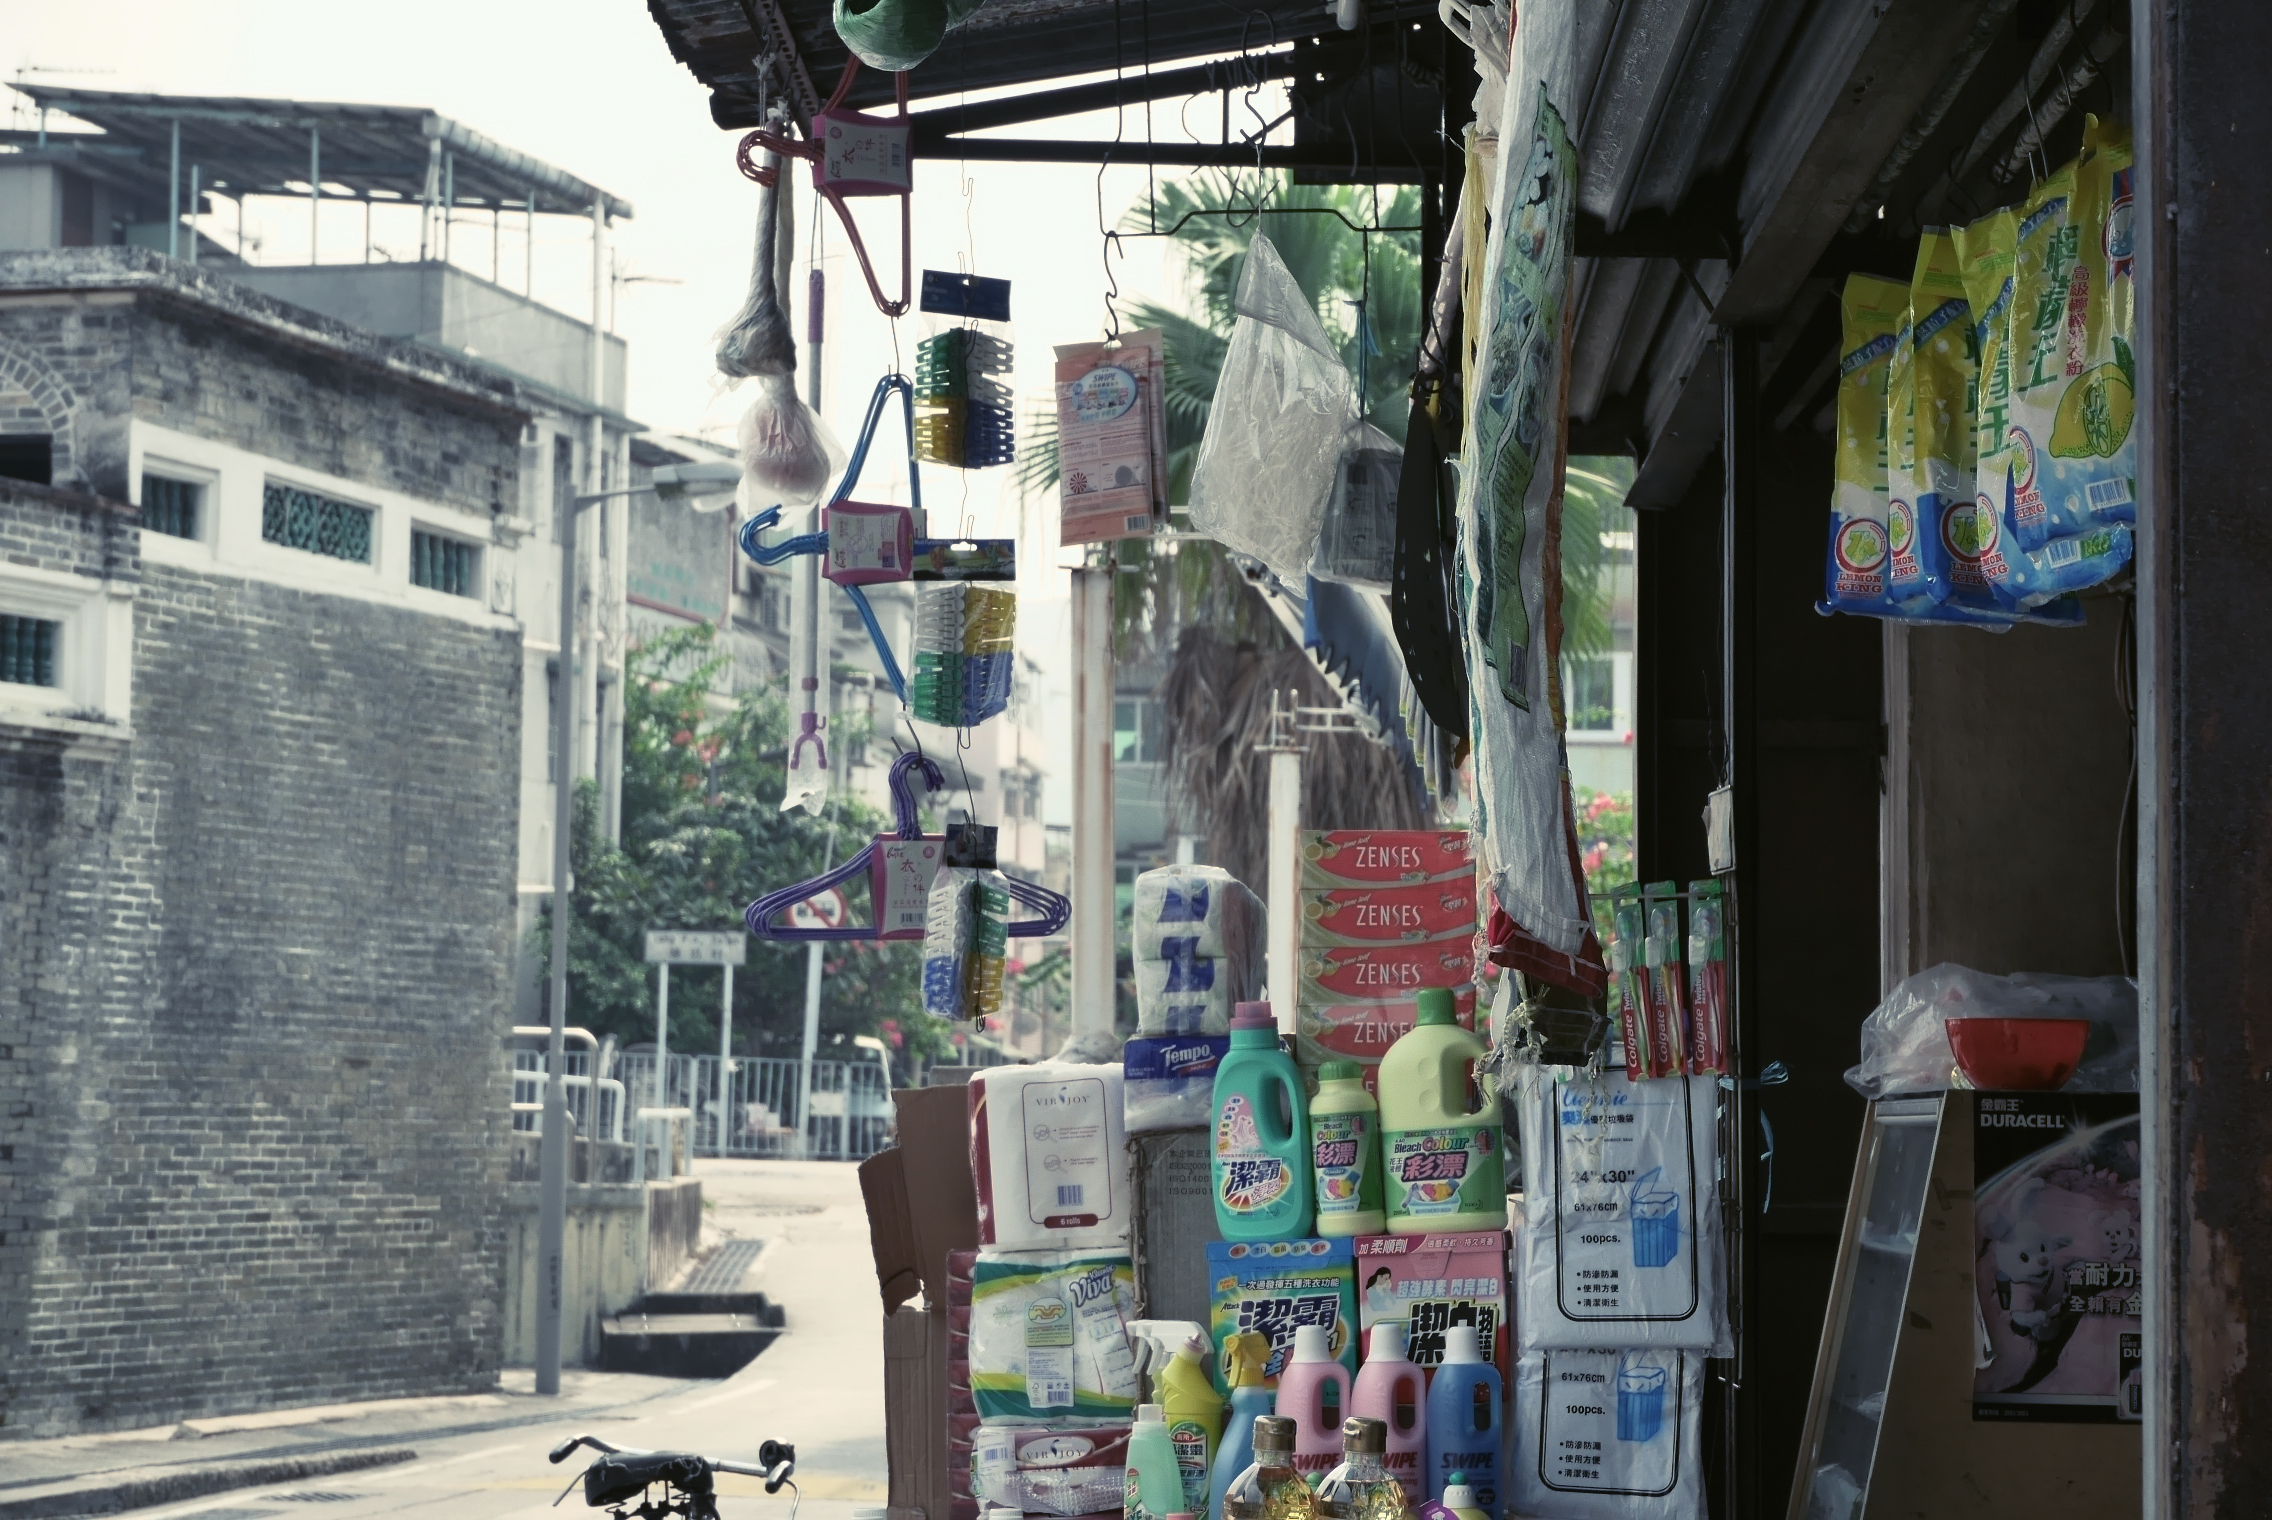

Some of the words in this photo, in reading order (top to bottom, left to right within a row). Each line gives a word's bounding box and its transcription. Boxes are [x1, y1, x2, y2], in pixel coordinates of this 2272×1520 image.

[2065, 265, 2091, 377] 高級檸檬洗衣粉
[1092, 372, 1118, 383] SWIPE
[1892, 555, 1914, 568] MON
[1981, 553, 2003, 568] MON
[1838, 573, 1882, 583] LEMON
[1892, 565, 1919, 579] ING
[1951, 572, 1984, 585] KIN
[1835, 582, 1884, 594] KING
[1356, 845, 1421, 868] ZENSES
[1356, 904, 1421, 927] ZENSES
[1355, 962, 1421, 986] ZENSES
[1353, 1021, 1416, 1044] ZENSE
[1656, 1009, 1669, 1063] Colgate
[1694, 1007, 1707, 1062] Colgate
[1626, 1013, 1637, 1068] Colgate
[1159, 1043, 1211, 1067] Tempo
[1980, 1098, 2020, 1112] 金霸王
[1980, 1113, 2065, 1129] DURACELL
[1317, 1129, 1352, 1141] Colour
[1394, 1142, 1422, 1154] Bleach
[1422, 1136, 1469, 1152] Colour
[1317, 1141, 1357, 1167] 彩漂
[1402, 1152, 1467, 1181] 彩漂
[1168, 1174, 1212, 1182] ISO1400
[1223, 1157, 1282, 1199] 潔霸
[1574, 1202, 1618, 1212] 61x76cm
[1060, 1218, 1066, 1226] 6
[1067, 1217, 1081, 1225] rolls
[1370, 1238, 1408, 1255] 柔順劑
[1580, 1234, 1621, 1245] 100pcs.
[2069, 1261, 2141, 1289] 當耐力
[1238, 1277, 1340, 1290] 一次過發揮五種洗衣功能
[1583, 1284, 1619, 1293] 使用方便
[1069, 1275, 1114, 1308] Viva
[1220, 1302, 1240, 1312] Attack
[1583, 1298, 1619, 1307] 清潔衛生
[1561, 1372, 1605, 1383] 61x76cm
[1566, 1405, 1606, 1415] 100pcs.
[1291, 1452, 1340, 1470] SWIPE
[1381, 1451, 1419, 1469] WIPE
[1441, 1452, 1494, 1470] SWIPE
[1564, 1454, 1601, 1465] 使用方便
[1563, 1469, 1600, 1479] 清潔衛生
